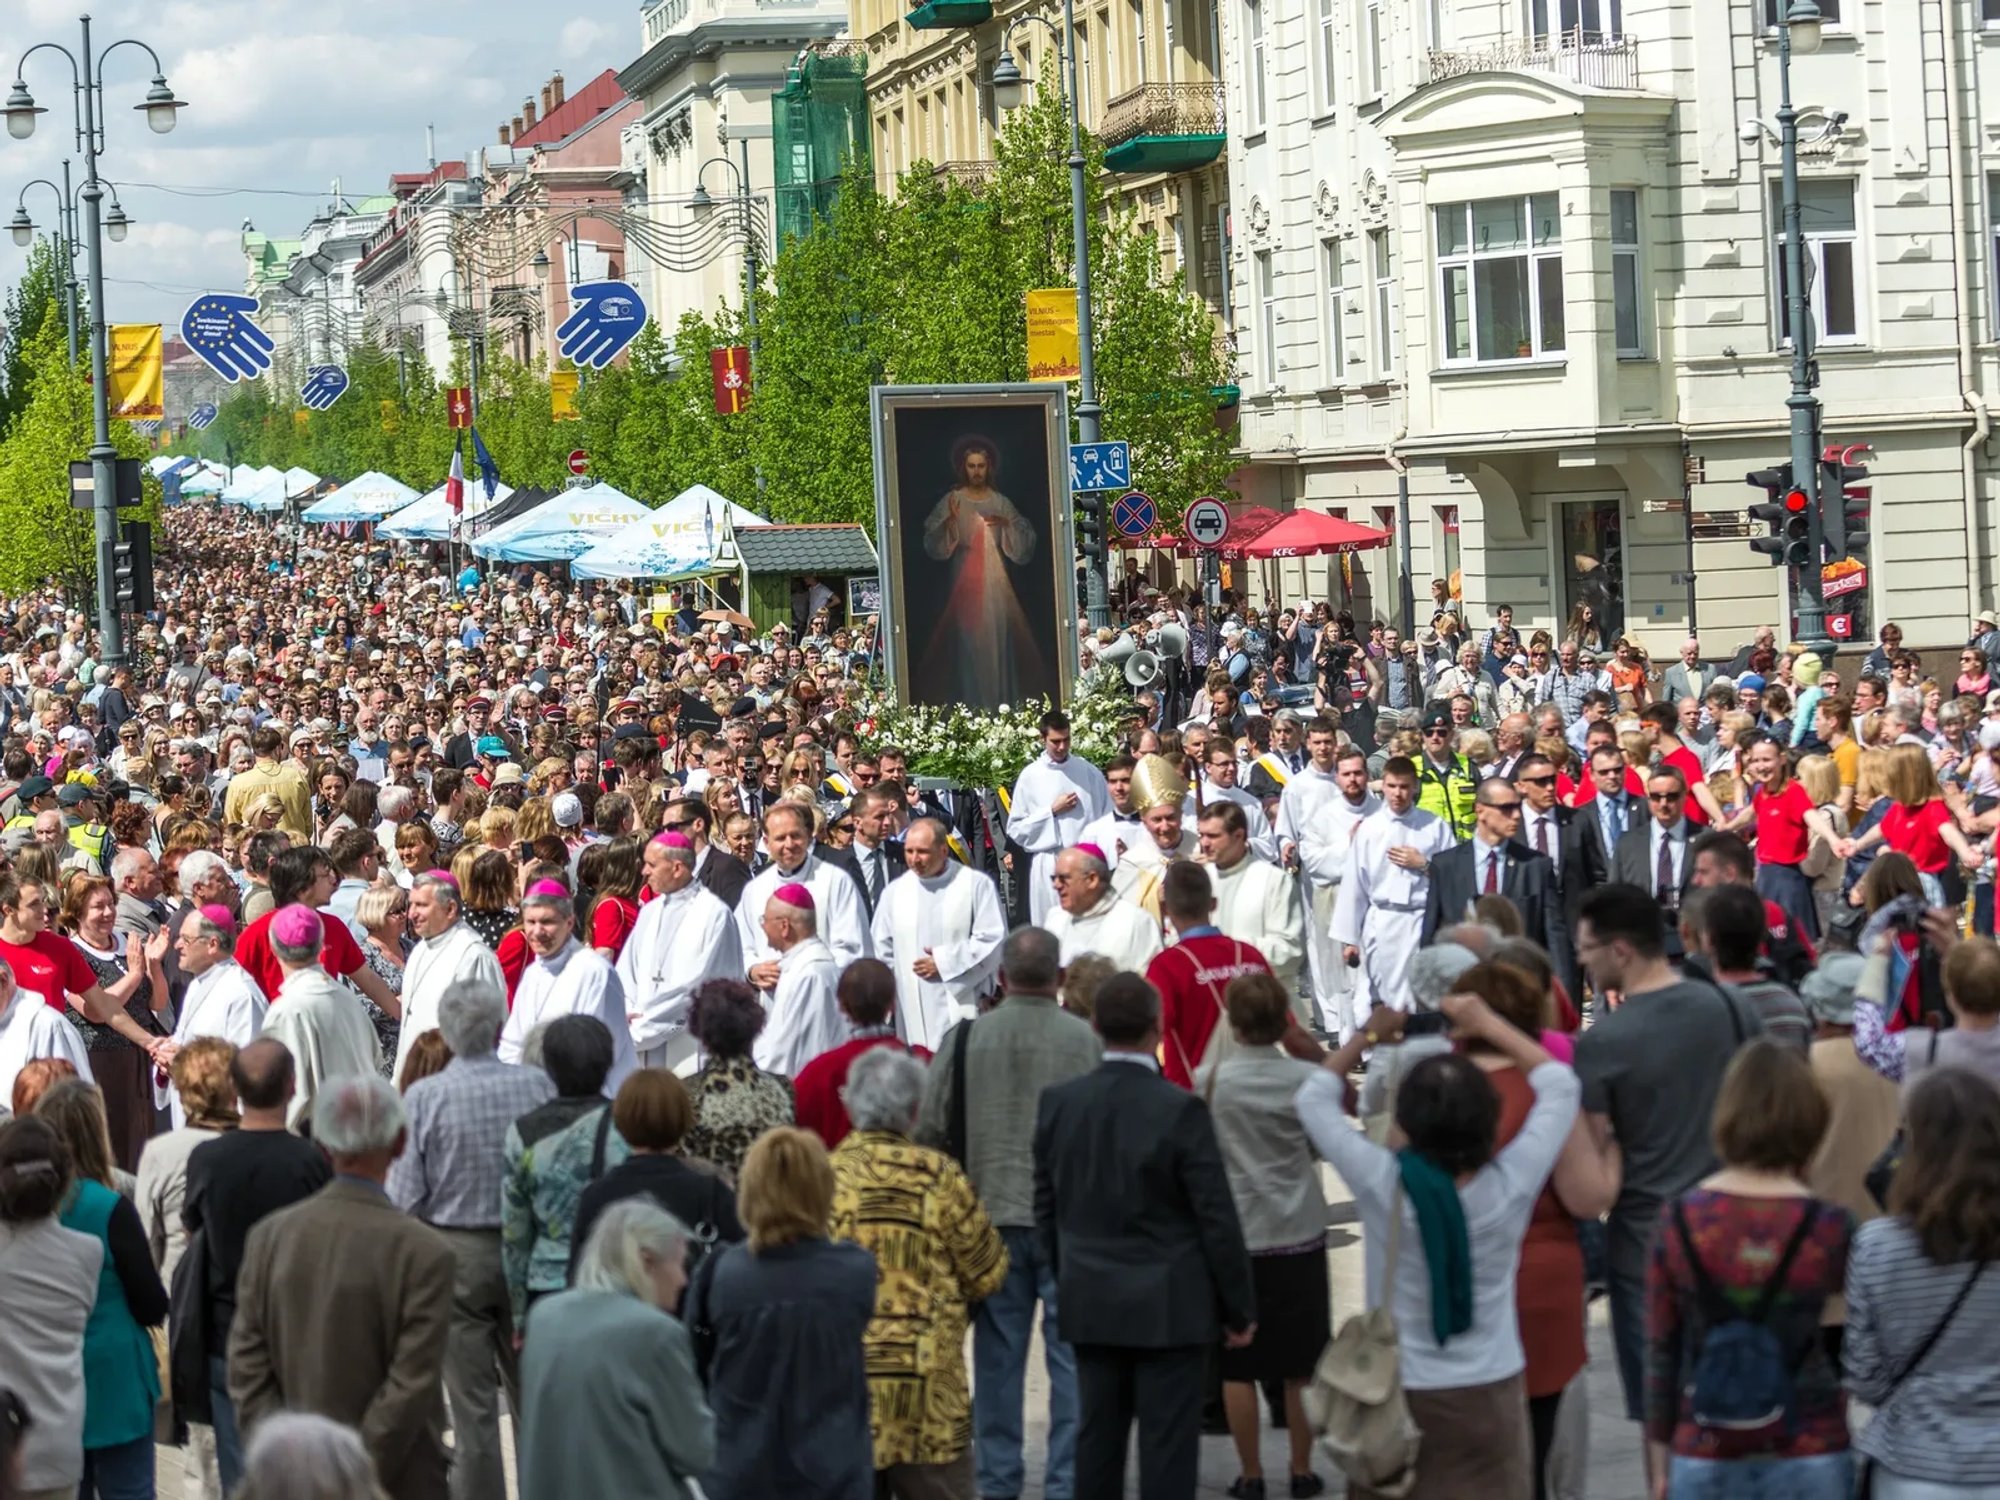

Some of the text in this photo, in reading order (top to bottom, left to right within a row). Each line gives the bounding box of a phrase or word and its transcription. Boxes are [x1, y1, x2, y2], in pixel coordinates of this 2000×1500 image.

[1137, 540, 1159, 548] KFC
[1339, 542, 1359, 551] KFC
[1272, 547, 1296, 556] KFC
